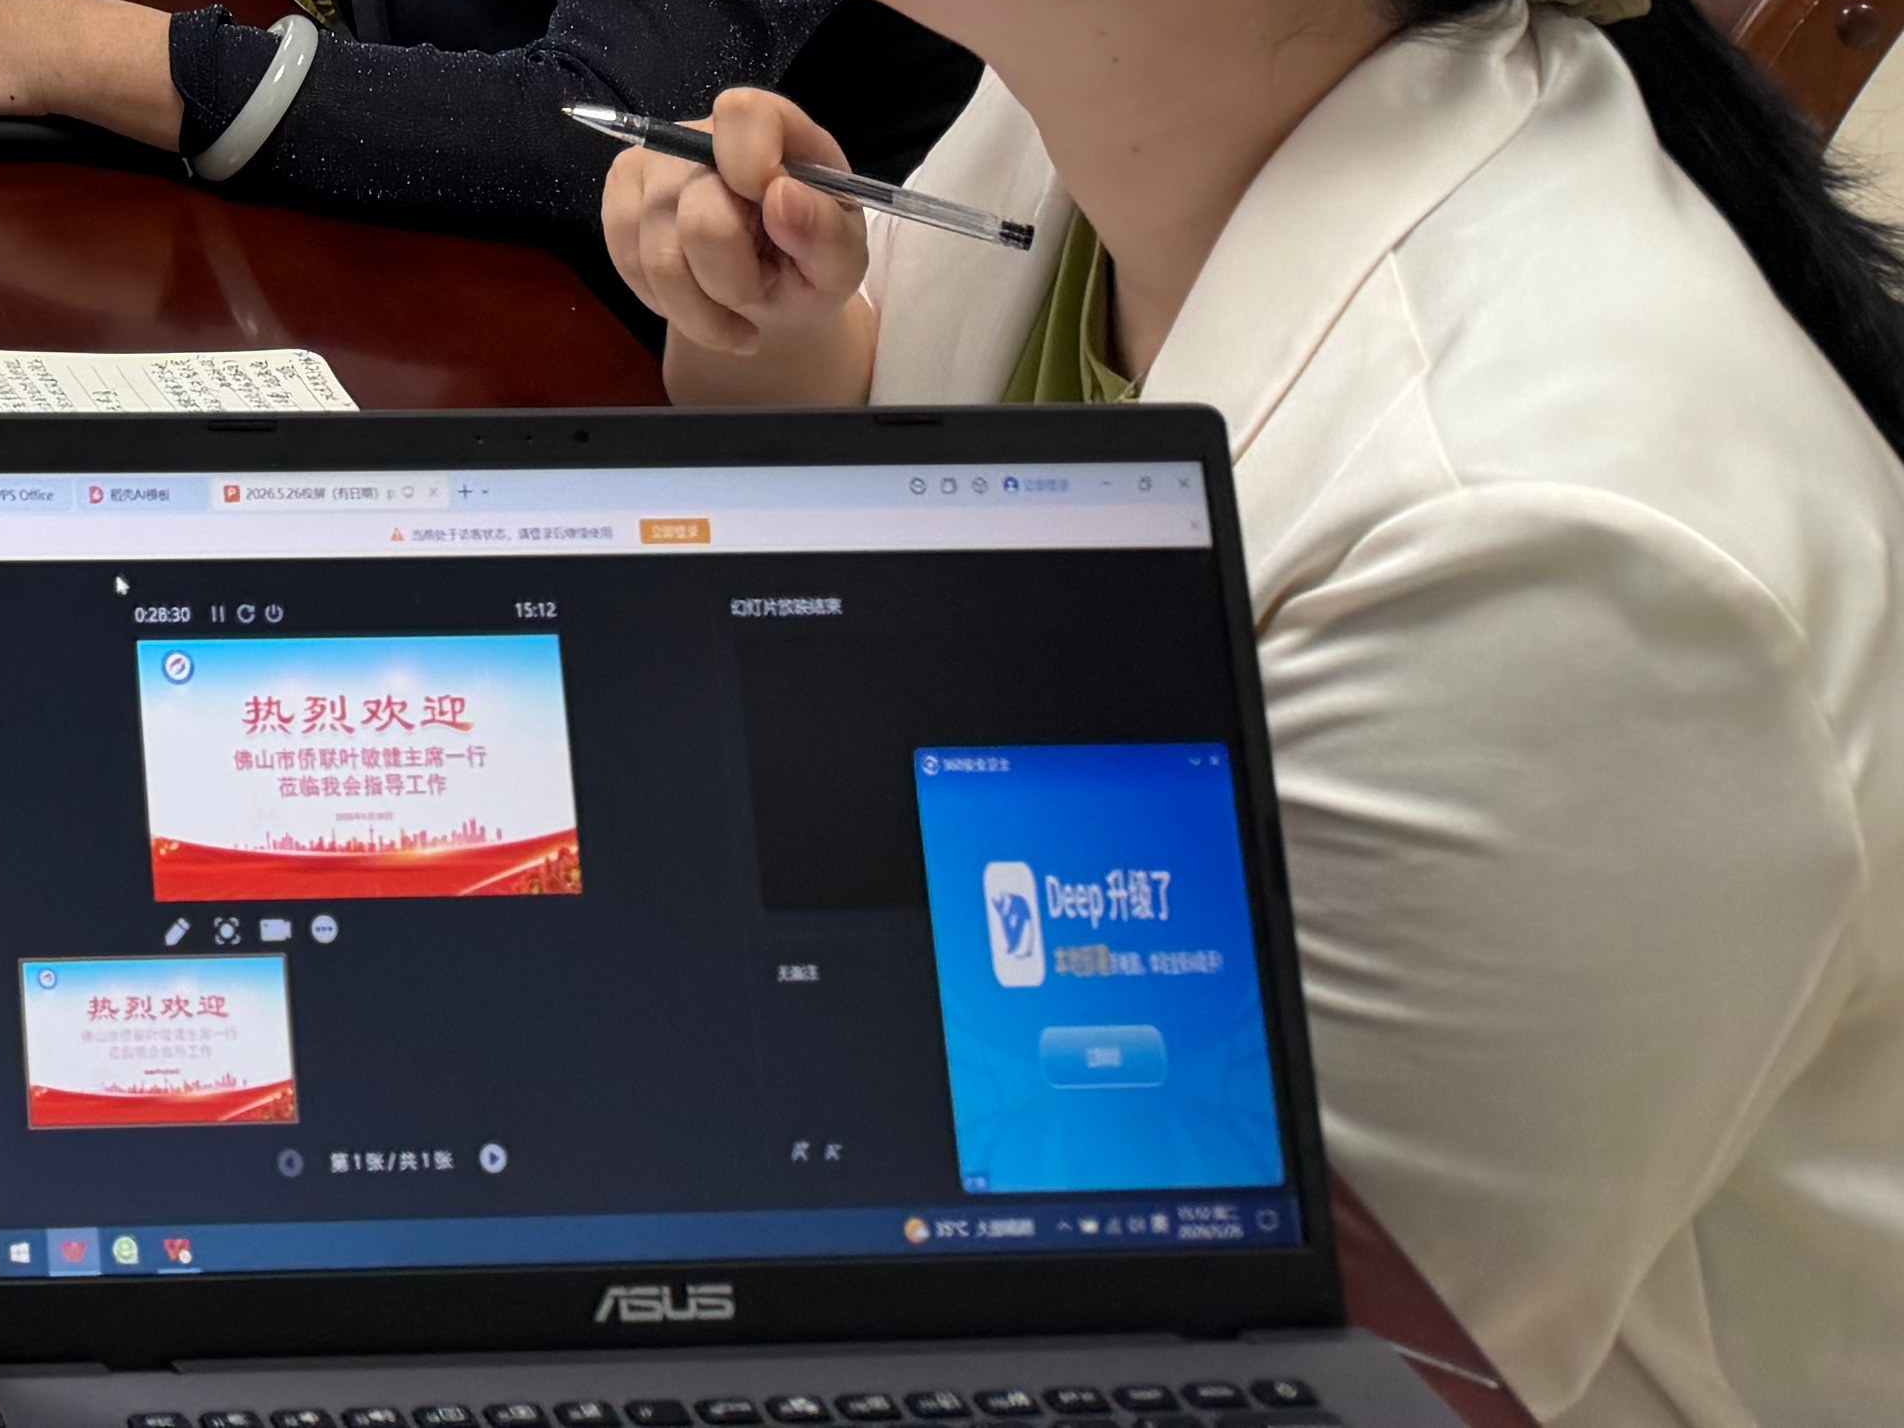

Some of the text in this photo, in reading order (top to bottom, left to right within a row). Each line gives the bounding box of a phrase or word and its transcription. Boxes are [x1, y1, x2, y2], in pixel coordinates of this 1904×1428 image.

[18, 487, 55, 503] Office
[133, 606, 192, 623] 0:28:30
[514, 602, 558, 618] 15:12
[240, 693, 475, 736] 热烈欢迎
[233, 745, 487, 771] 佛山市侨联叶敏健主席一行
[277, 773, 448, 799] 莅临我会指导工作
[87, 994, 231, 1020] 热烈欢迎
[592, 1283, 736, 1323] ASUS
